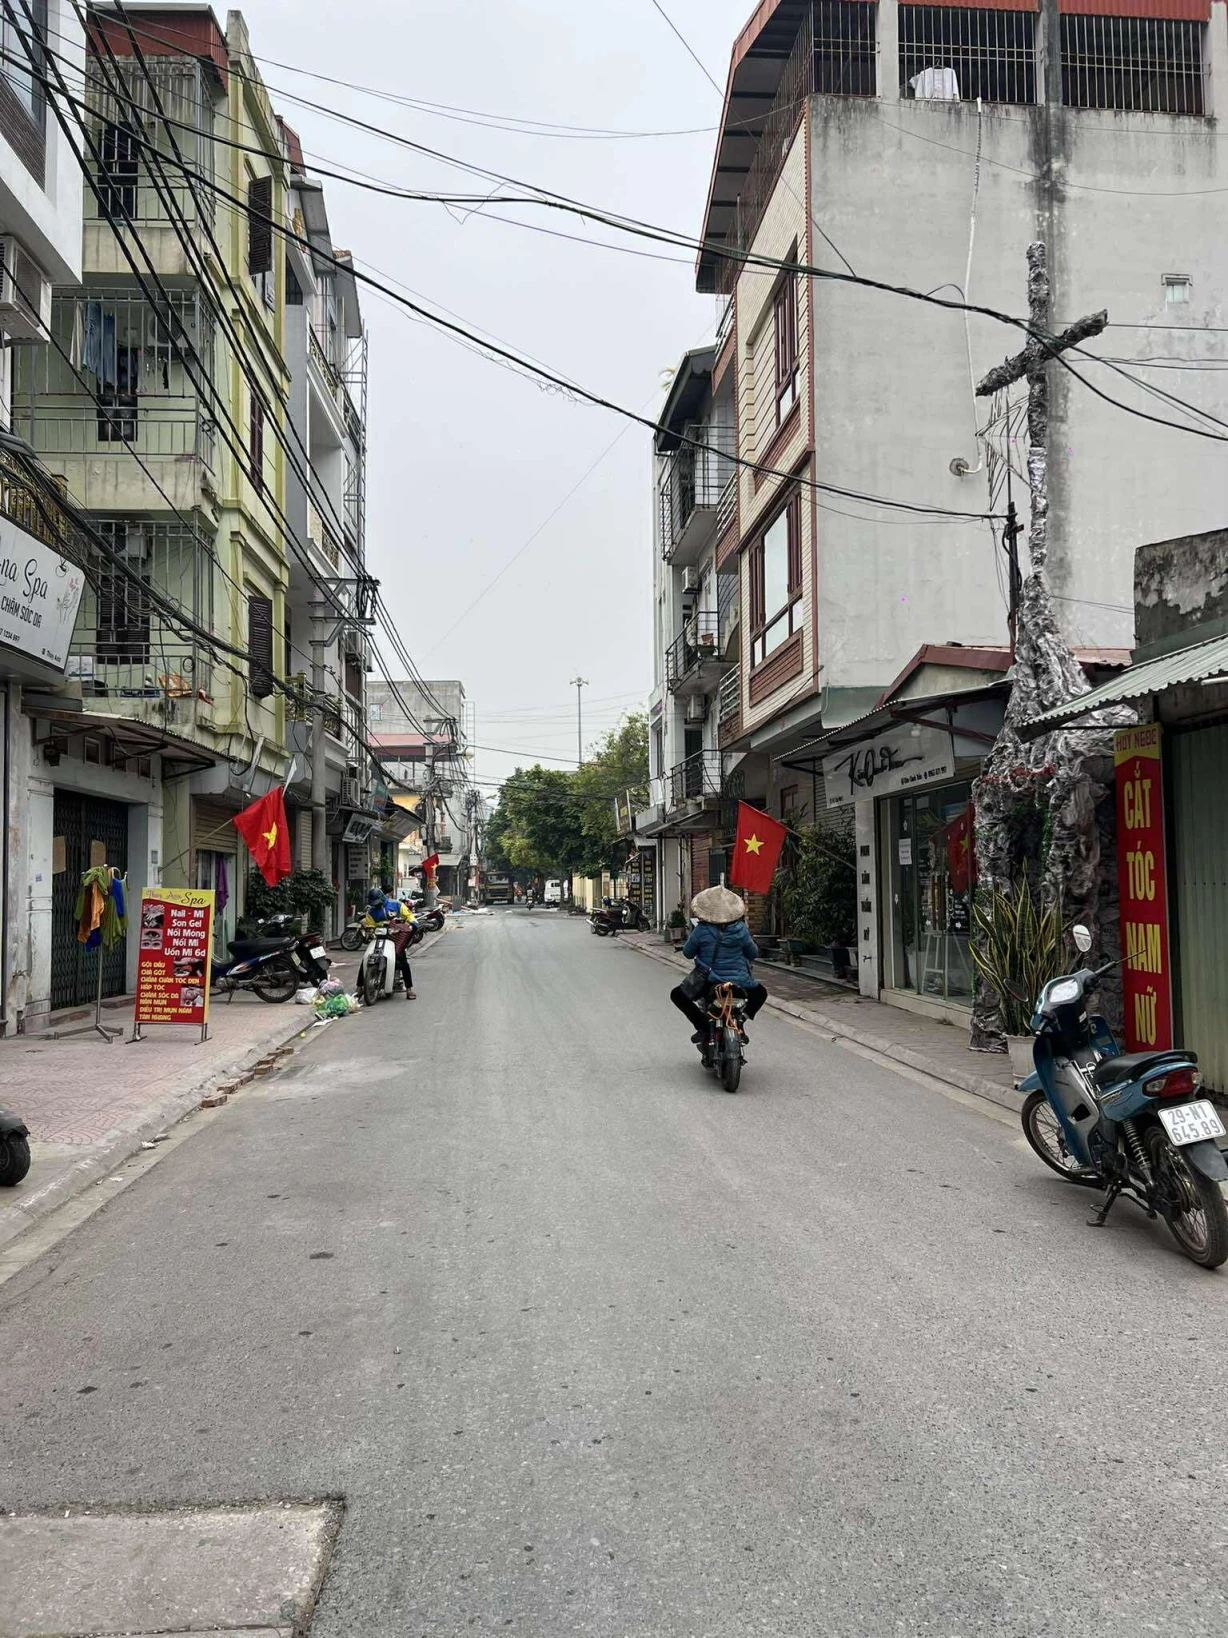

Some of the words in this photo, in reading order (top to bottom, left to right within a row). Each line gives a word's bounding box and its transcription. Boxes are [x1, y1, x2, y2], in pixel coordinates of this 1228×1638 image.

[0, 559, 18, 582] na
[23, 558, 48, 603] Spa
[20, 605, 33, 624] SÓC
[33, 614, 42, 628] DA
[1116, 734, 1131, 751] HUY
[1124, 760, 1151, 830] CẮT
[1126, 841, 1155, 901] TÓC
[181, 891, 205, 907] Spa
[171, 909, 186, 917] Nail
[193, 910, 204, 918] Mi
[189, 920, 202, 928] Gel
[167, 928, 180, 936] Nối
[182, 929, 206, 939] Móng
[172, 937, 186, 946] Nối
[188, 939, 199, 947] Mi
[164, 946, 180, 956] Uốn
[182, 948, 193, 956] Mi
[1126, 922, 1162, 974] NAM
[1134, 986, 1157, 1046] NỮ
[1168, 1104, 1207, 1125] 29-N1
[1172, 1119, 1220, 1142] 645.89
